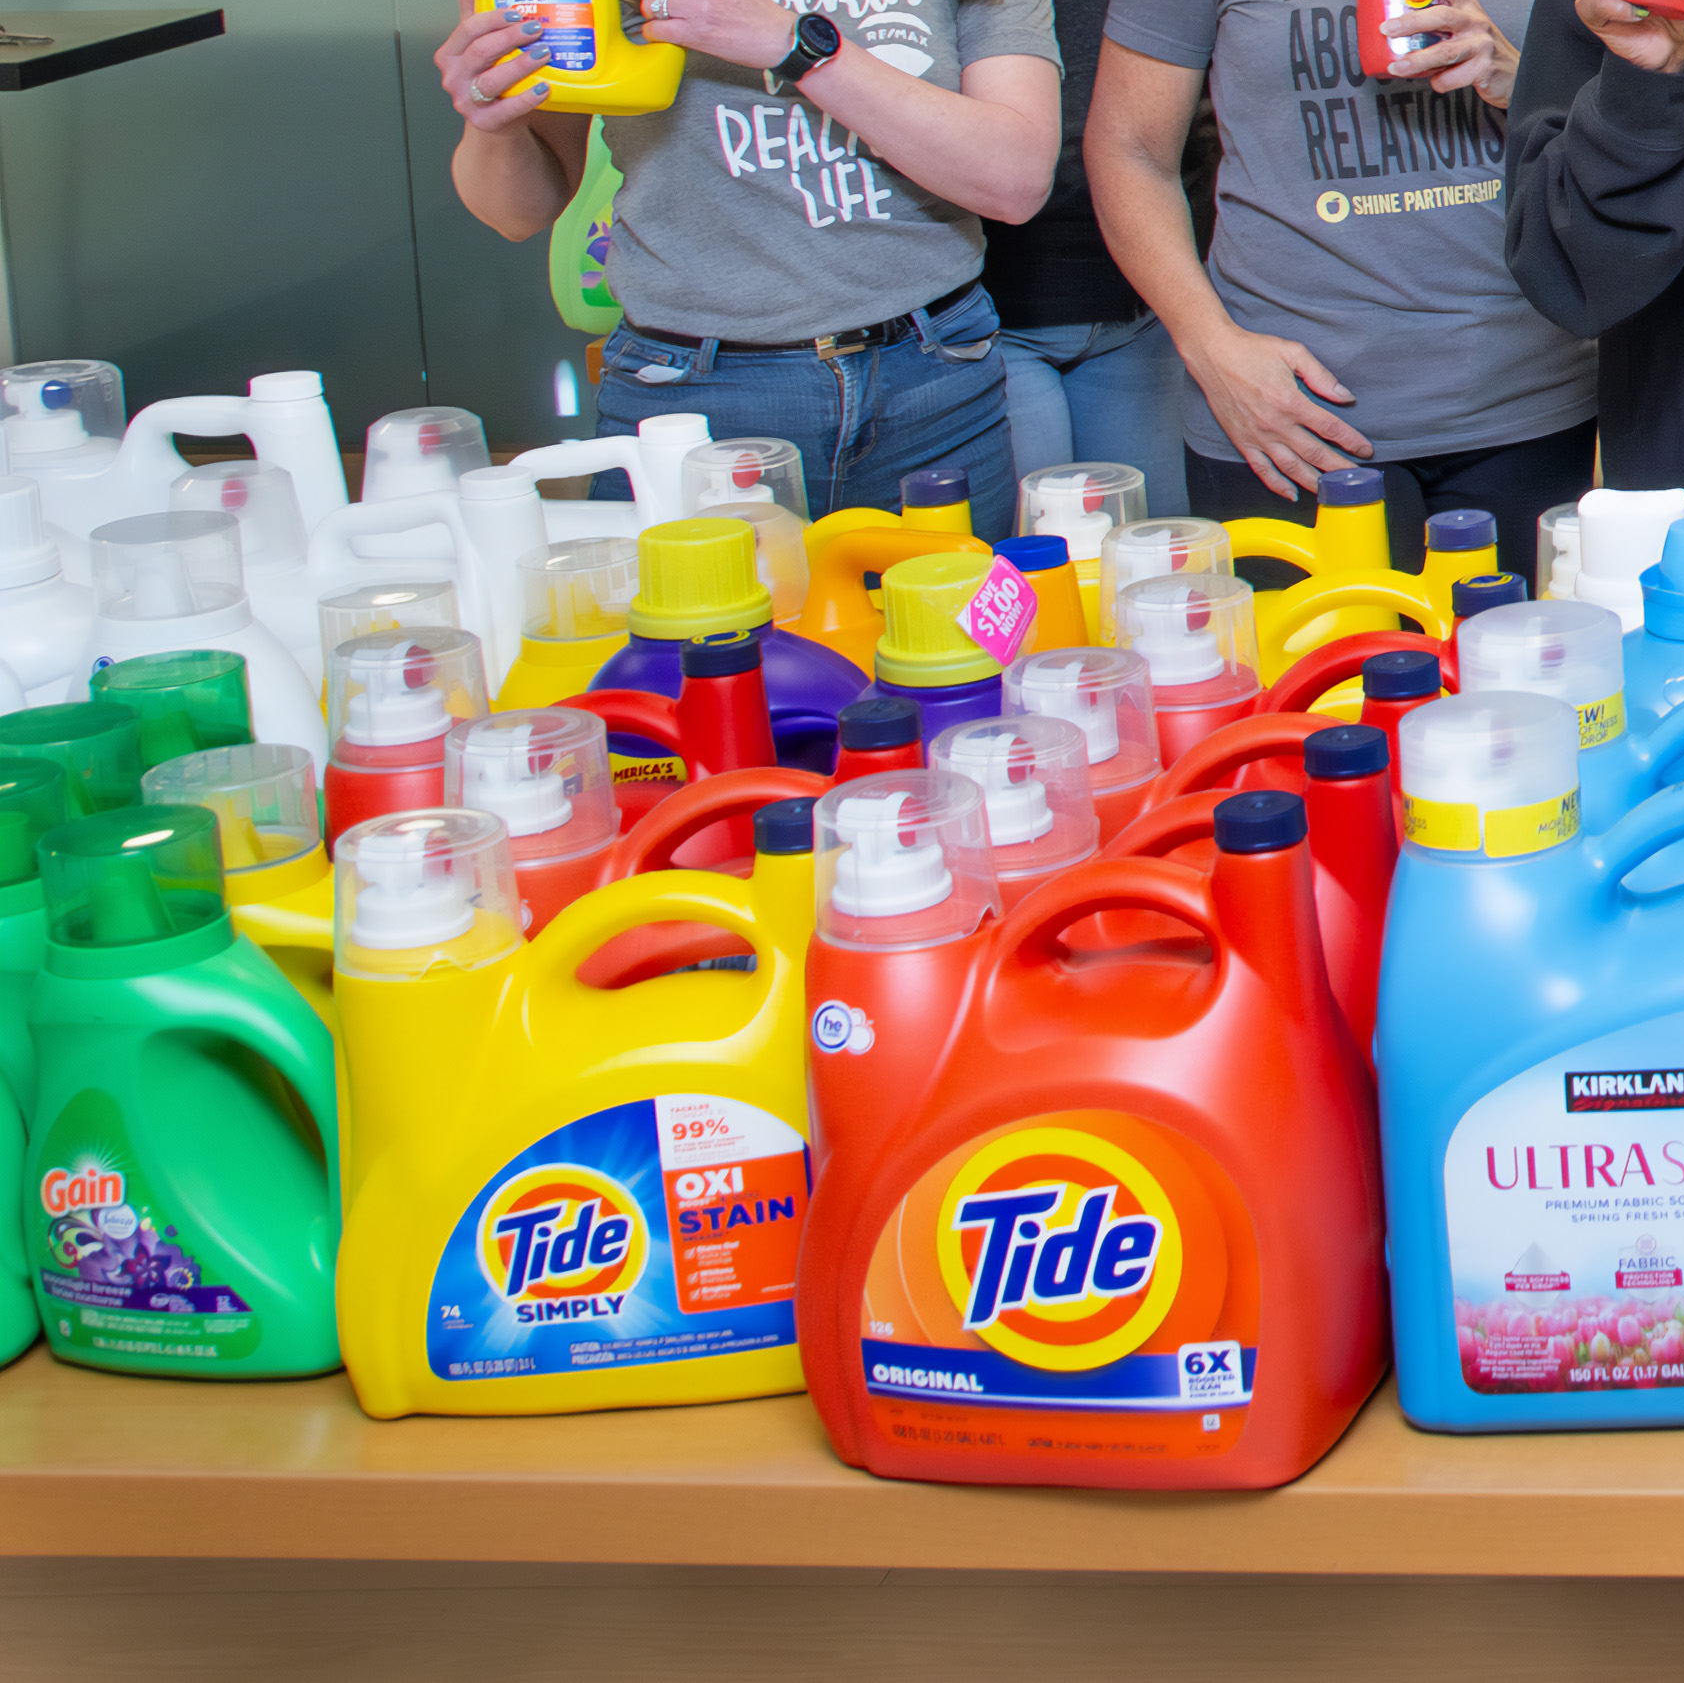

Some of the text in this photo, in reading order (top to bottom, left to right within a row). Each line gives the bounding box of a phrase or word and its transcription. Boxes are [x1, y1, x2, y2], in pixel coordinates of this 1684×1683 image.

[866, 27, 928, 47] RE/MAX
[790, 158, 892, 228] LIFE
[1352, 179, 1502, 216] SHINE PARTNERSHIP
[974, 579, 999, 609] SAVE
[977, 578, 1019, 637] $1.00
[999, 600, 1025, 638] NOW!
[1578, 704, 1605, 725] EW!
[1578, 715, 1618, 736] OFTNESS
[614, 762, 674, 782] MERICA'S
[822, 1015, 844, 1034] he
[672, 1116, 729, 1140] 99%
[44, 1168, 122, 1213] Gain
[675, 1166, 745, 1199] OXI
[678, 1196, 796, 1235] STAIN
[1546, 1198, 1610, 1210] PREMIUM
[1615, 1196, 1664, 1208] FABRIC
[1572, 1213, 1620, 1224] SPRING
[1626, 1211, 1669, 1221] FRESH
[496, 1199, 630, 1297] Tide
[957, 1188, 1159, 1326] Tide
[1620, 1256, 1676, 1270] FABRIC
[440, 1304, 462, 1319] 74
[515, 1294, 625, 1324] SIMPLY
[1184, 1349, 1233, 1376] 6X
[1595, 1367, 1610, 1381] FL
[1613, 1366, 1631, 1380] OZ
[872, 1363, 985, 1394] ORIGINAL
